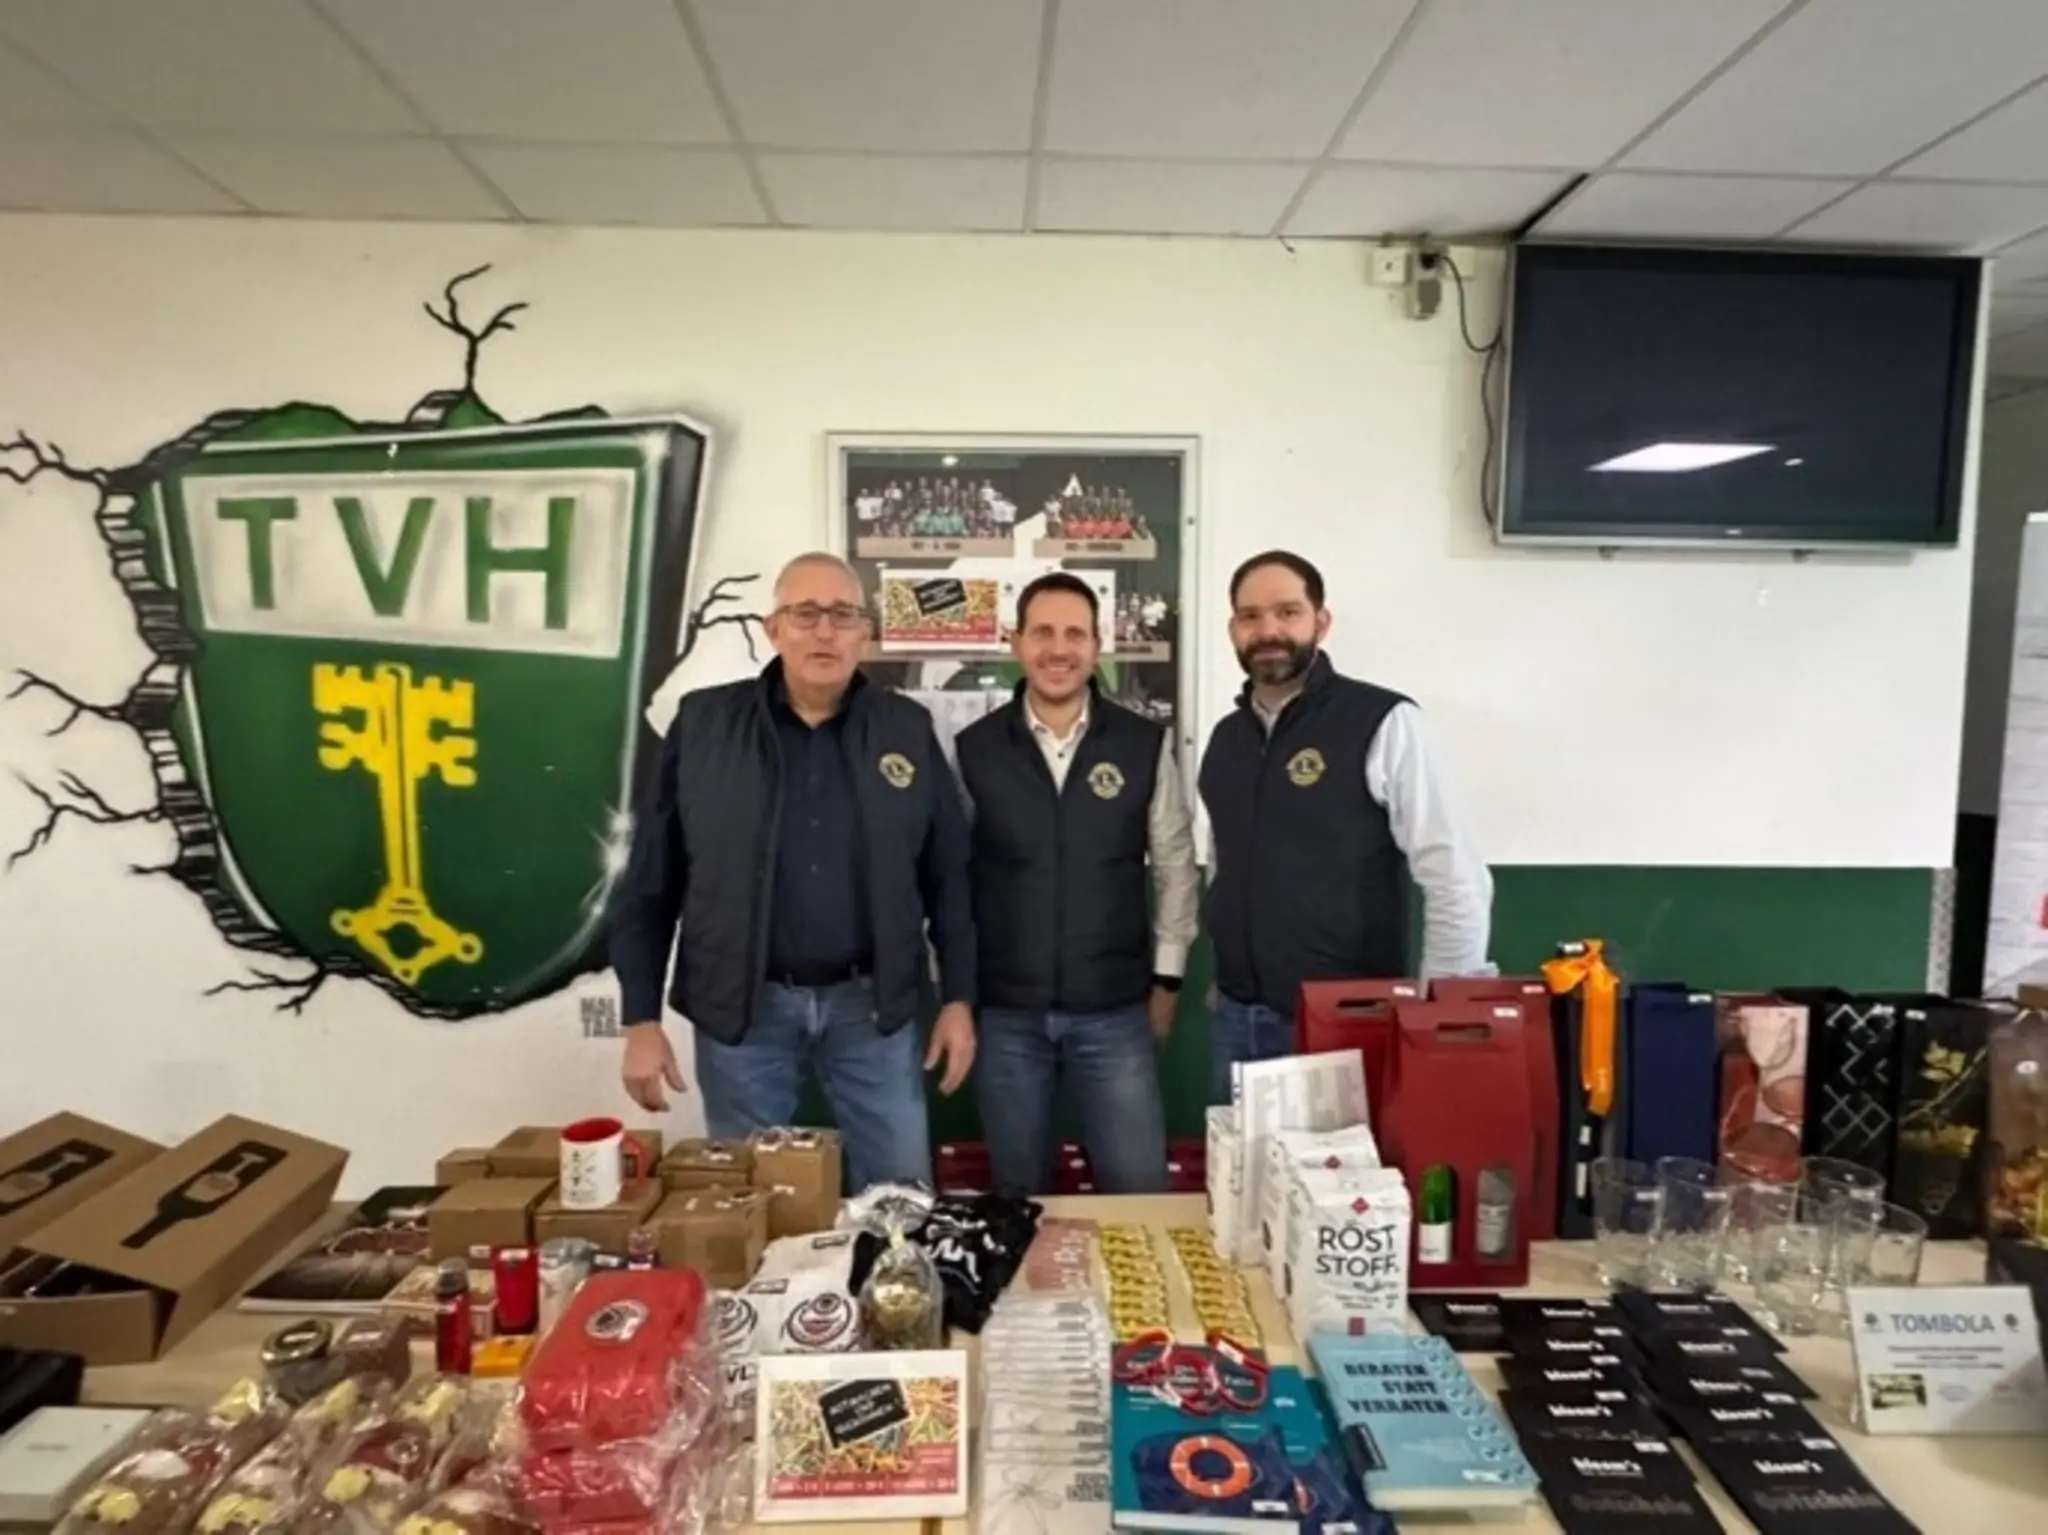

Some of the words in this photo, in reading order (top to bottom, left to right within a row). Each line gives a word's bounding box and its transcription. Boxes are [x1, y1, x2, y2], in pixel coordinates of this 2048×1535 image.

[1890, 1313, 1995, 1333] TOMBOLA
[1343, 1363, 1428, 1377] BERATEN
[1382, 1381, 1438, 1395] STATT
[1347, 1400, 1450, 1414] VERRATEN
